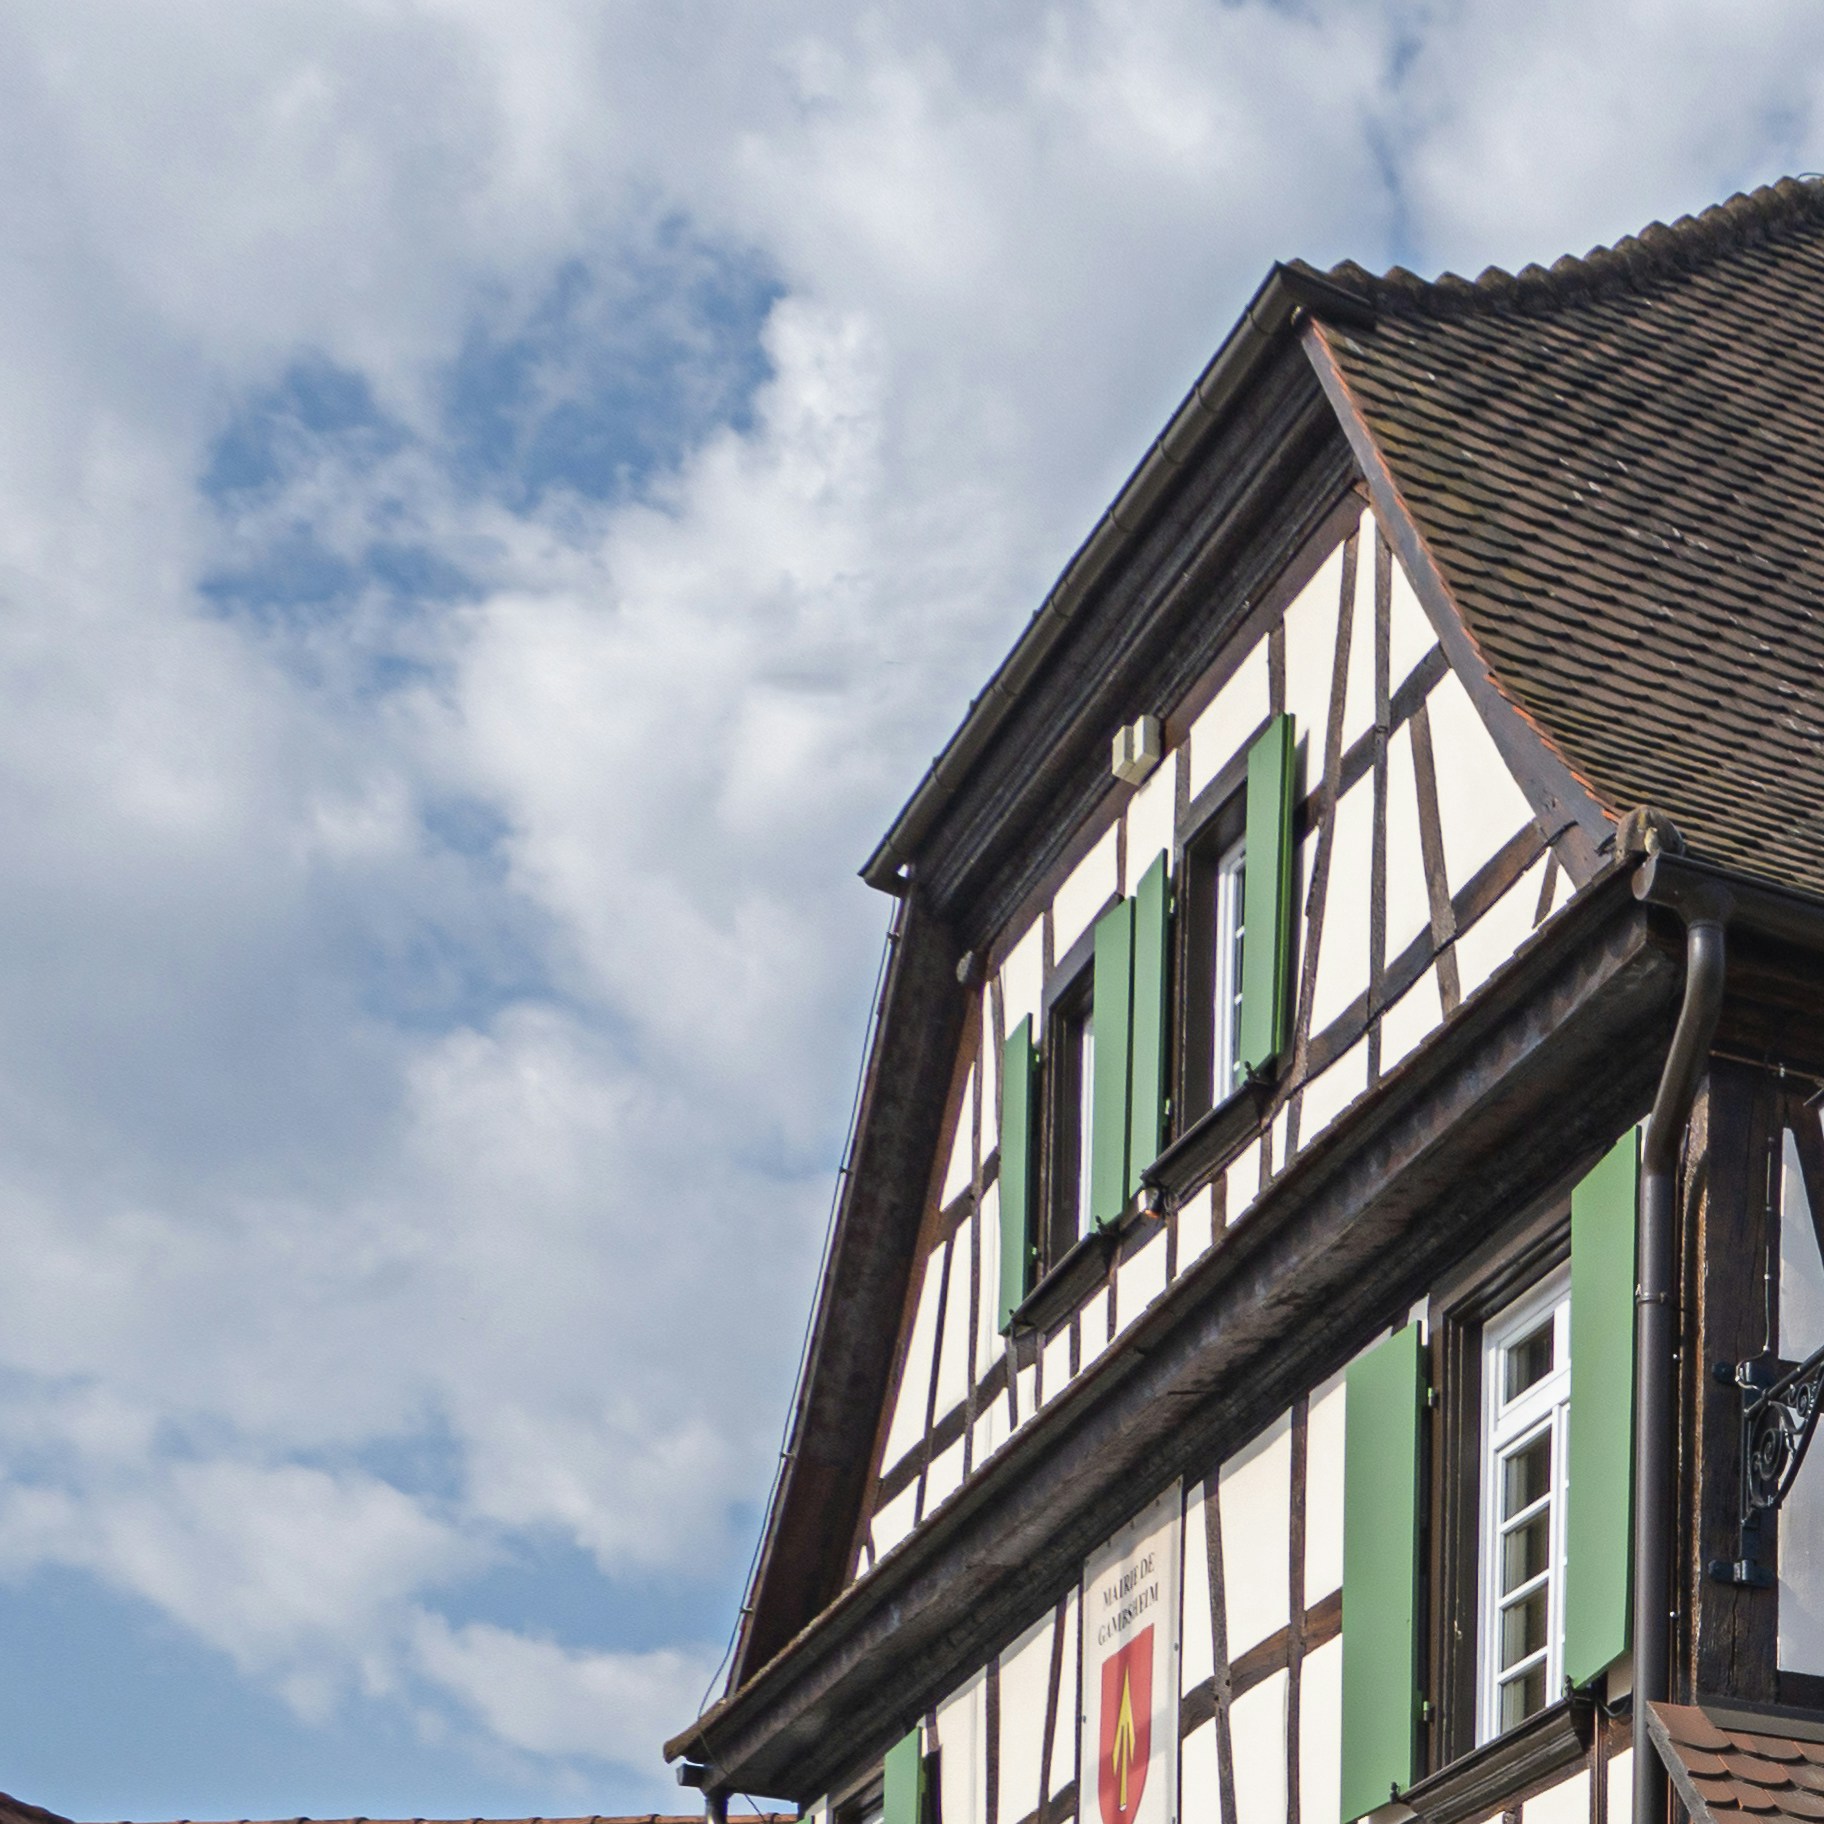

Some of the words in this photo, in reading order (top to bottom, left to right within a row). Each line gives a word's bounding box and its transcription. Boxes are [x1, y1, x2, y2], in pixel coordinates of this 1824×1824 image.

[1103, 1564, 1140, 1606] MAIRIE
[1140, 1552, 1155, 1579] DE
[1098, 1581, 1159, 1646] GAMBSHEIM
